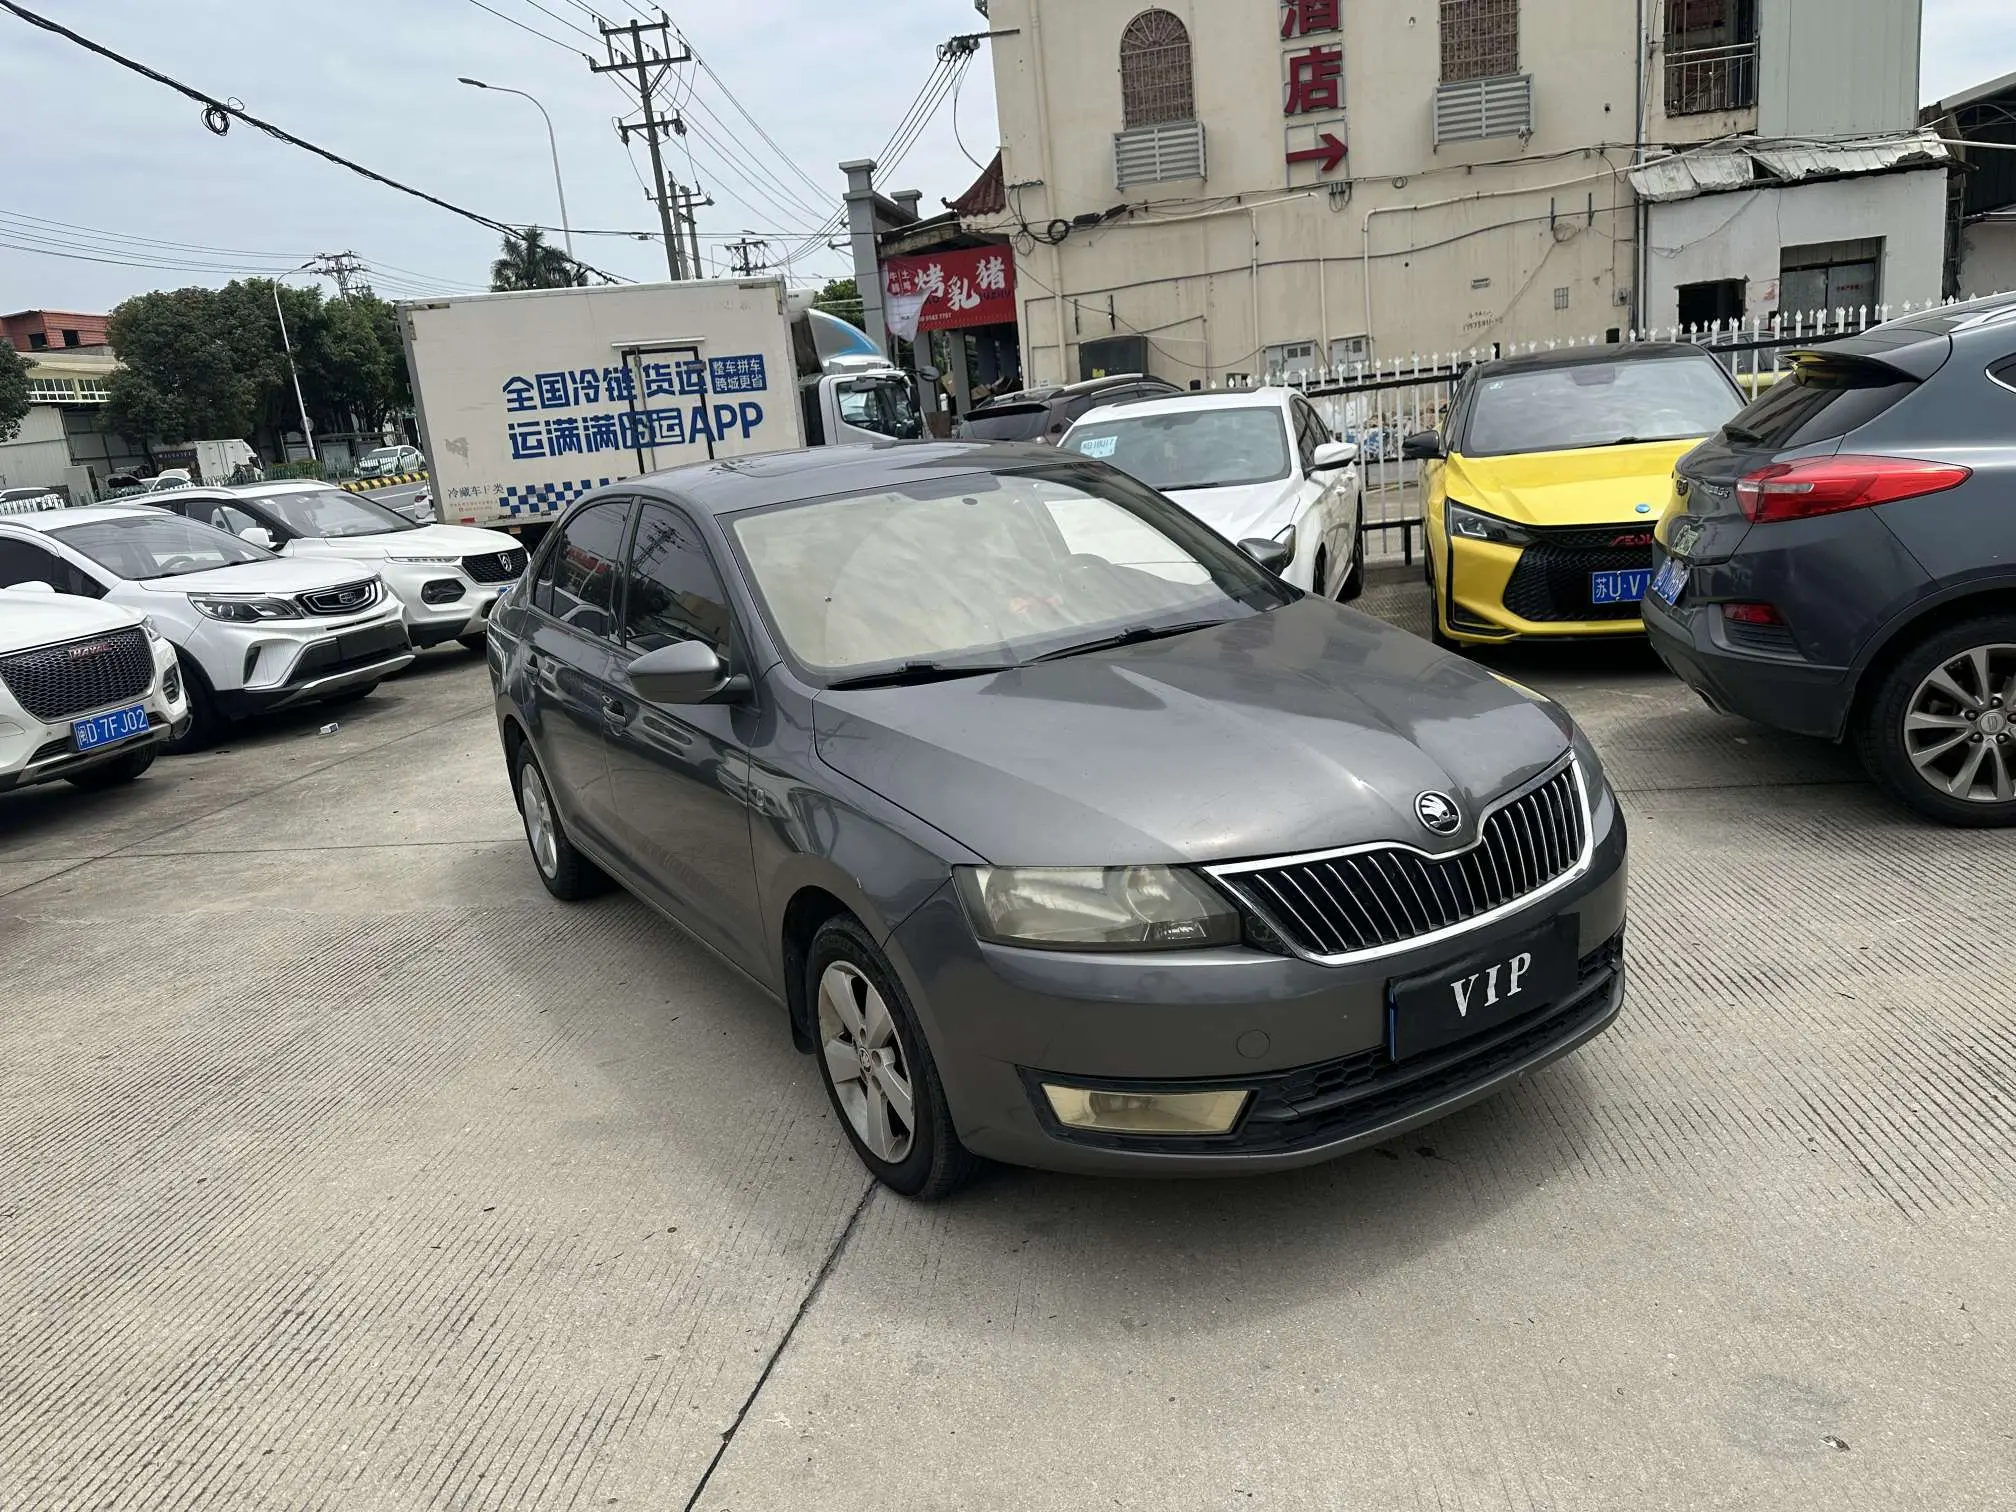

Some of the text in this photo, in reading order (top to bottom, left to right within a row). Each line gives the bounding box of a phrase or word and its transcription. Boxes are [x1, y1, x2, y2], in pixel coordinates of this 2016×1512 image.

[914, 256, 1006, 311] 烤乳猪
[503, 360, 708, 413] 全国冷链货运
[712, 358, 761, 375] 整车拼车
[715, 374, 763, 391] 跨城更省
[1450, 952, 1531, 1017] VIP
